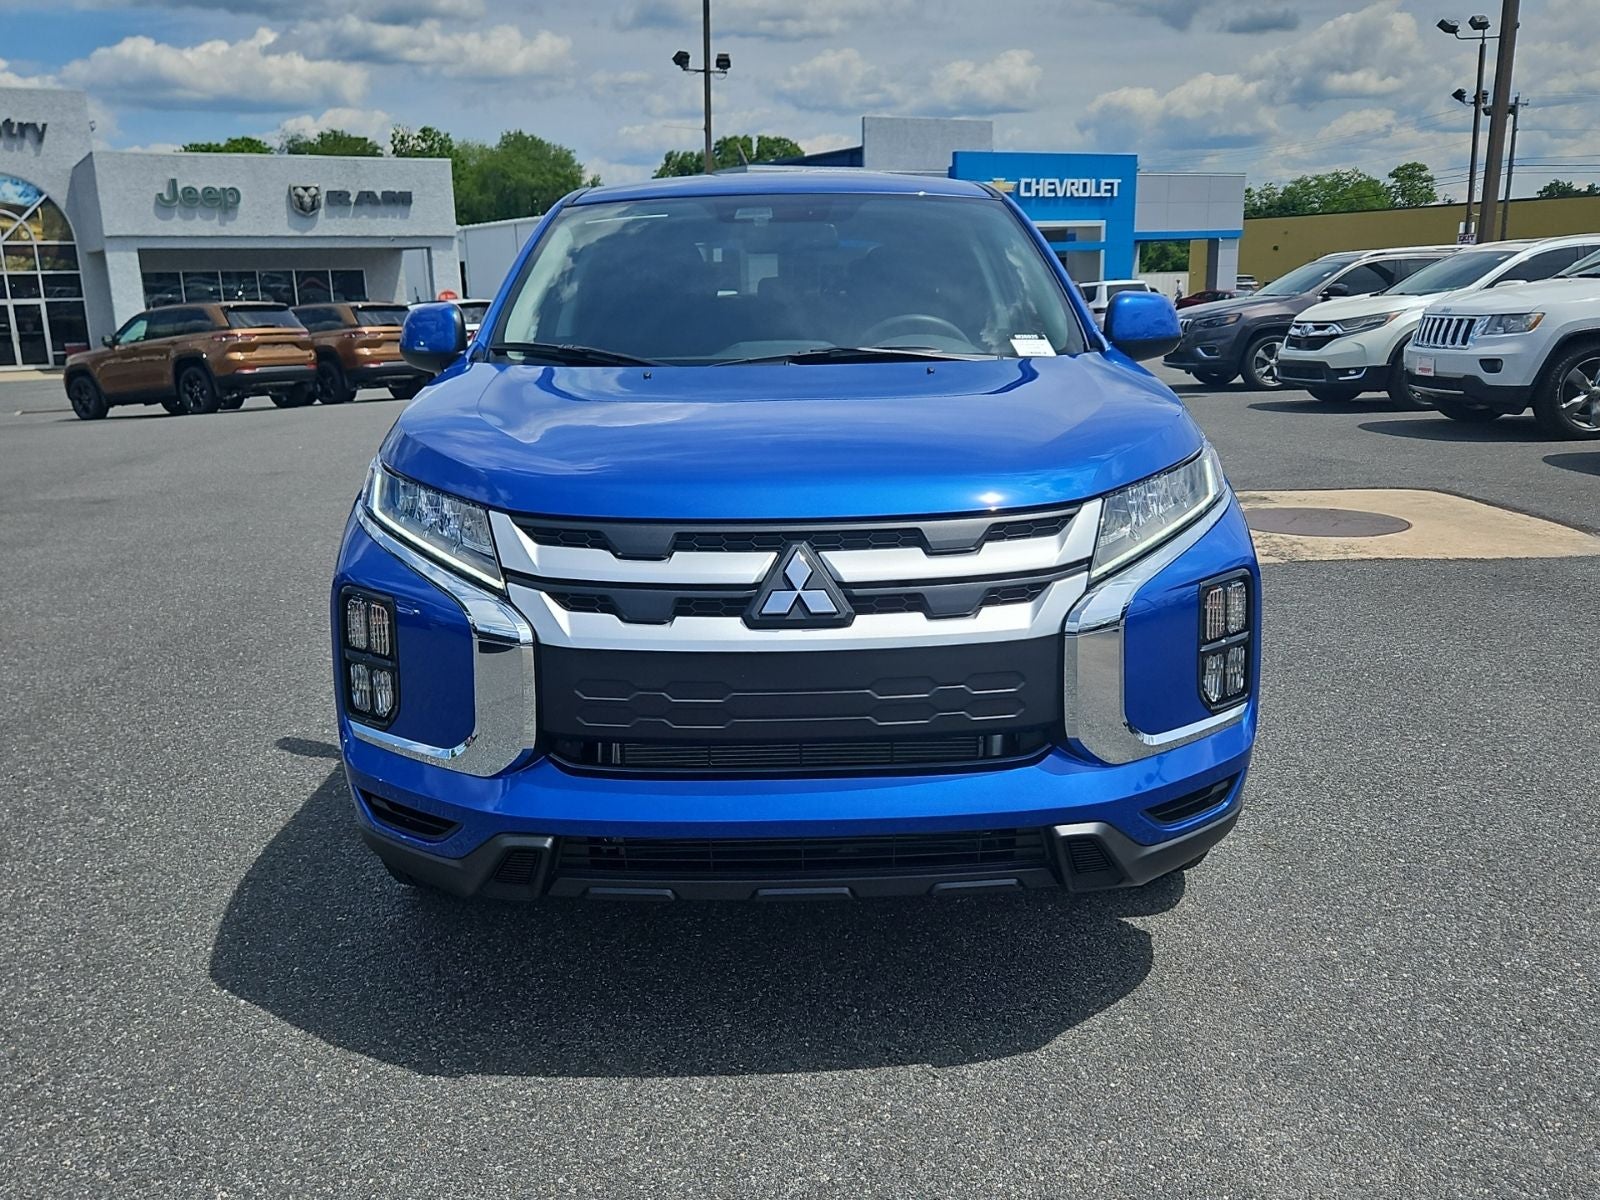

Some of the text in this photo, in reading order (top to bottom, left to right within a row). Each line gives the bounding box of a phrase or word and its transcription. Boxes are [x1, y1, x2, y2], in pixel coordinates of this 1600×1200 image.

[0, 118, 48, 144] try
[155, 178, 241, 214] Jeep
[326, 190, 412, 206] RAM
[1019, 178, 1122, 197] CHEVROLET
